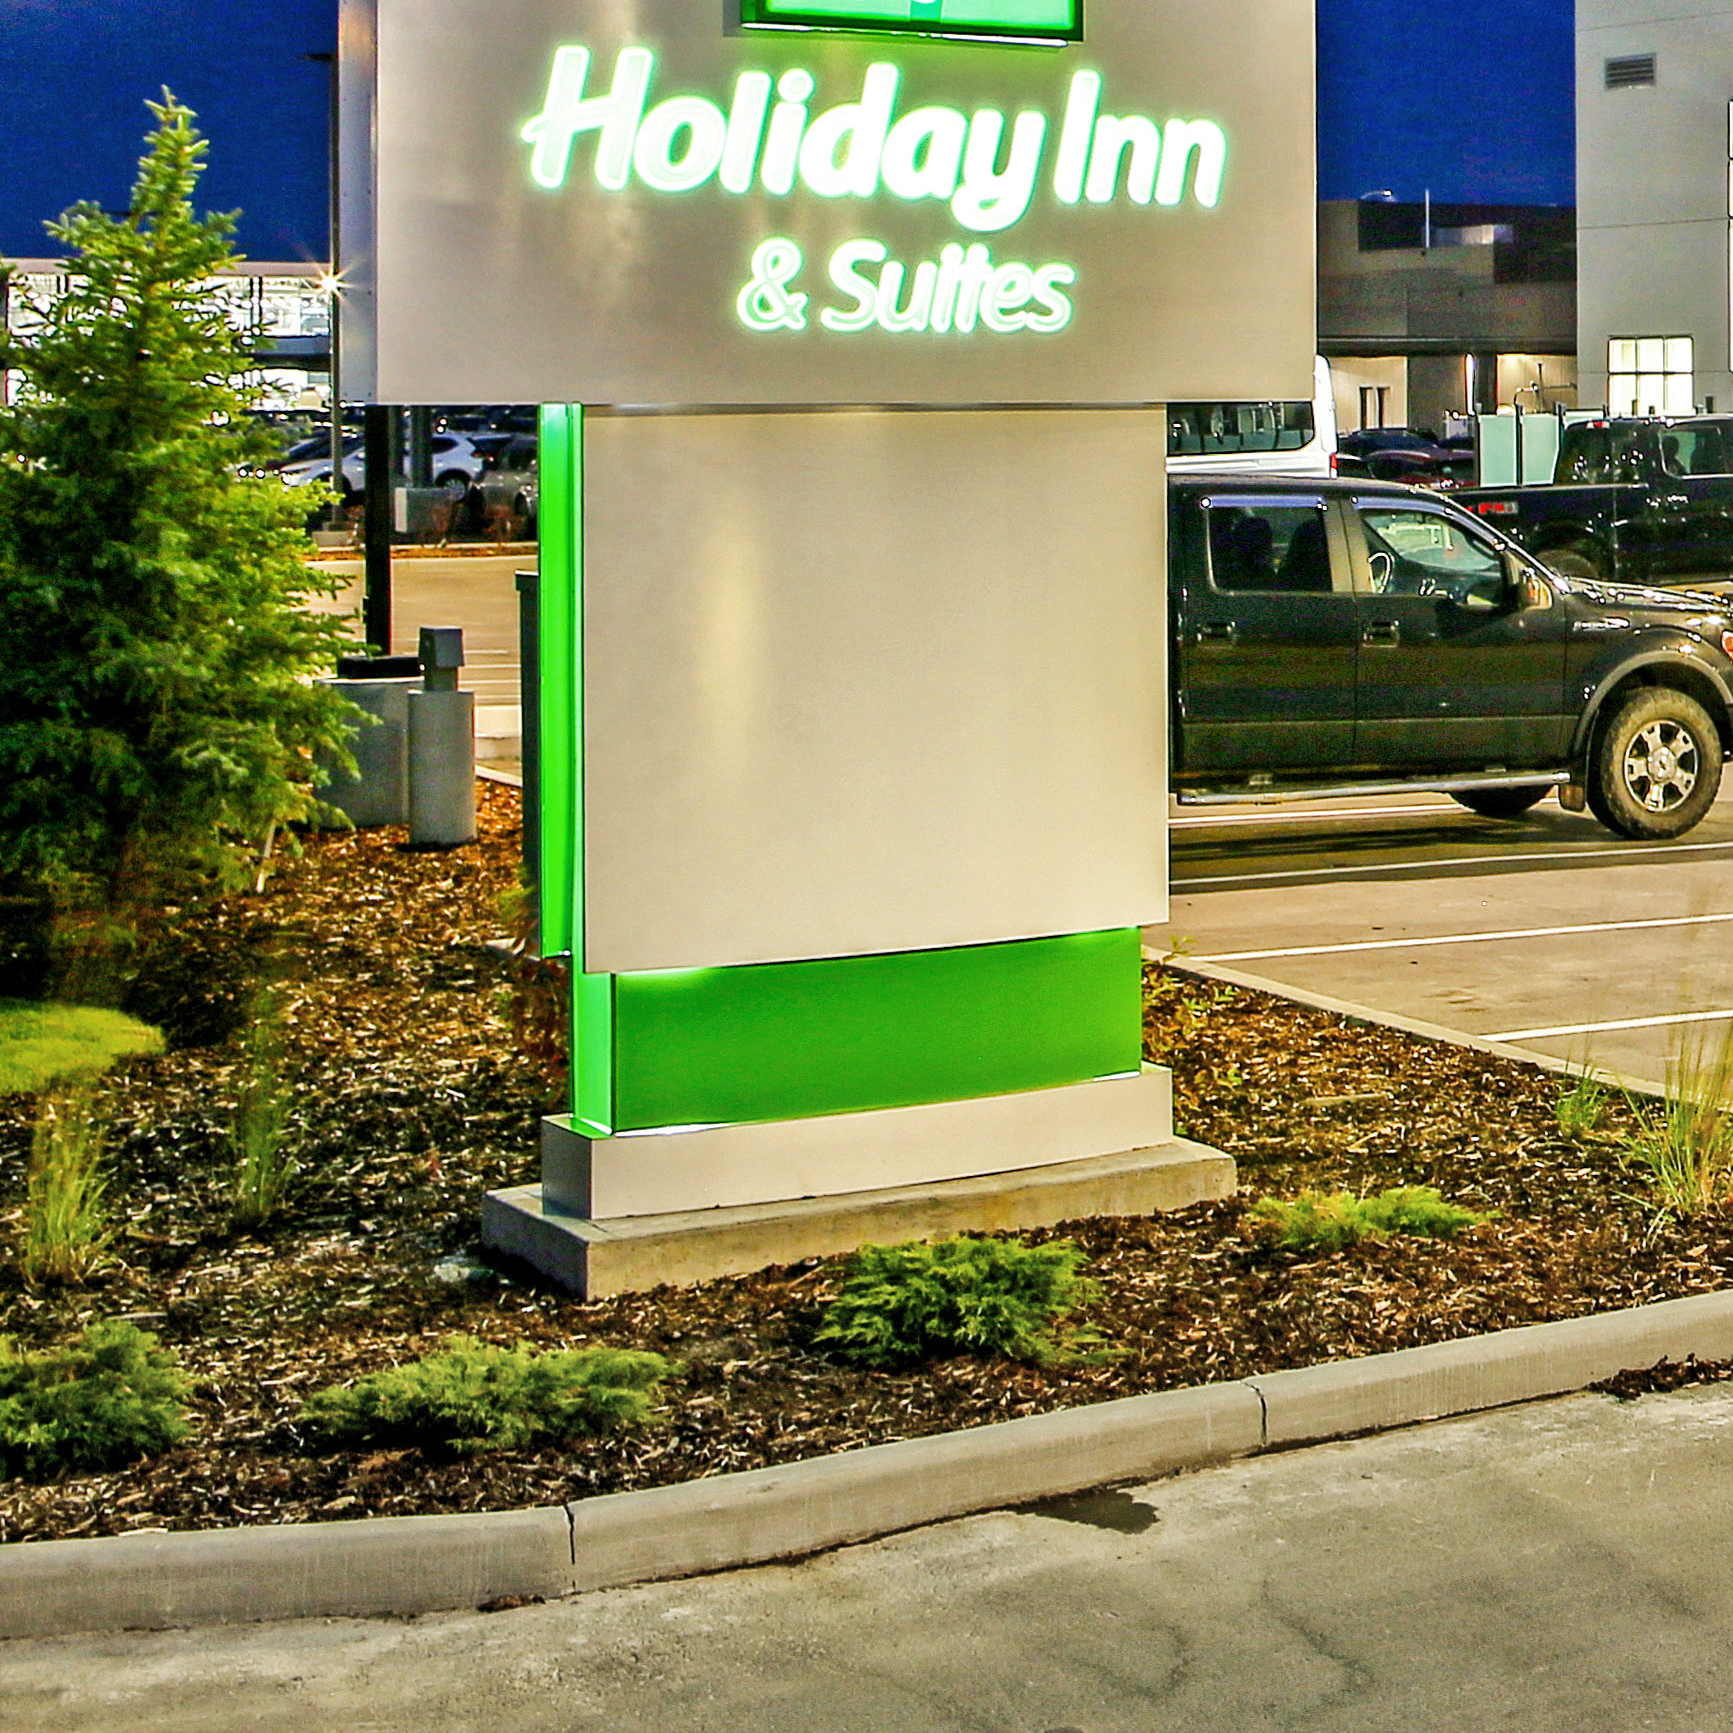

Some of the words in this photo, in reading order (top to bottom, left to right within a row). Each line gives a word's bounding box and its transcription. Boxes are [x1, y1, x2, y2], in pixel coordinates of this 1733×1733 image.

[521, 44, 1045, 232] Holiday
[1053, 68, 1228, 208] Inn
[736, 237, 809, 331] &
[820, 238, 1077, 334] Suites
